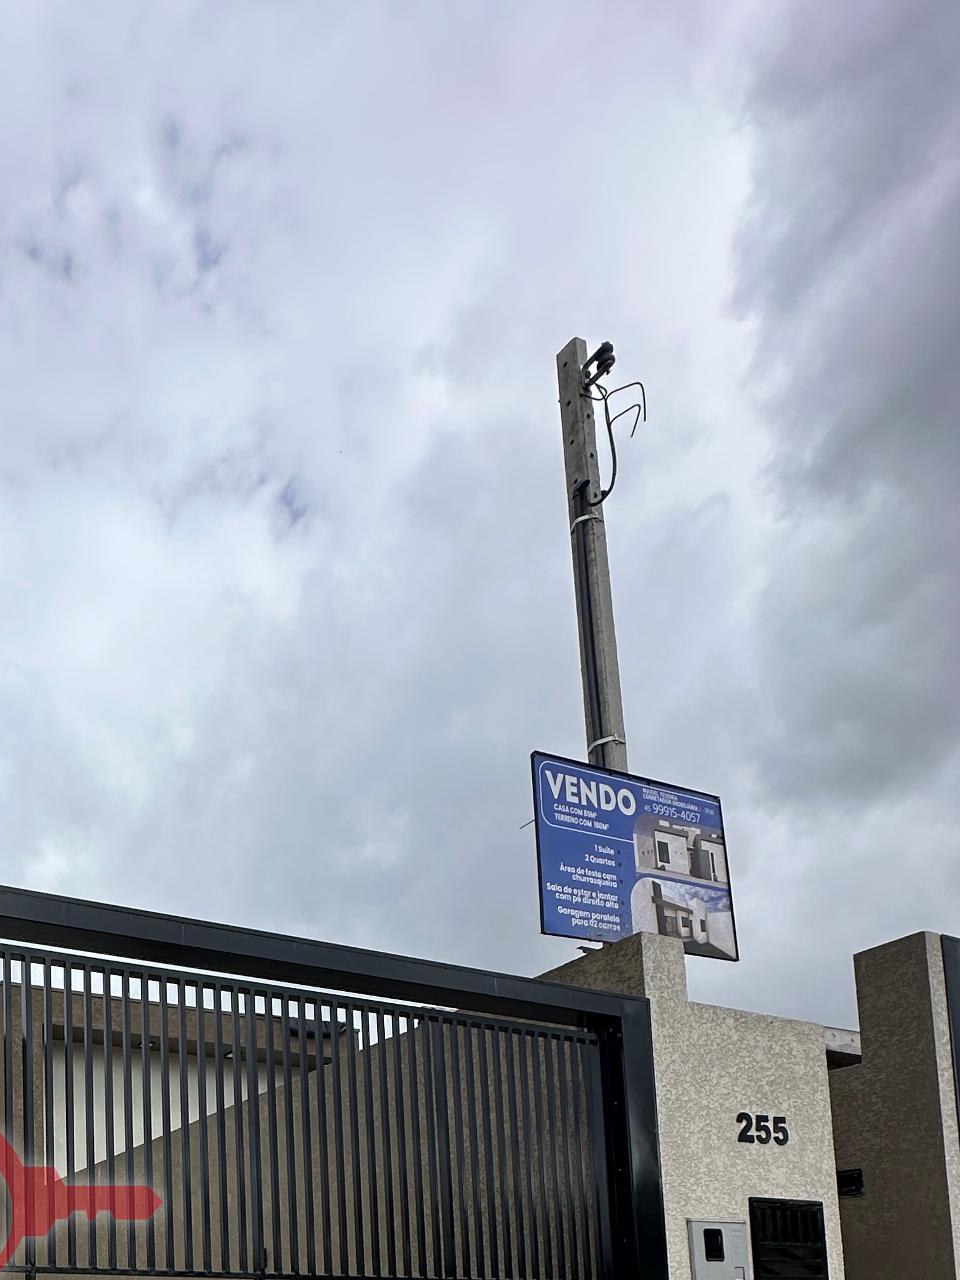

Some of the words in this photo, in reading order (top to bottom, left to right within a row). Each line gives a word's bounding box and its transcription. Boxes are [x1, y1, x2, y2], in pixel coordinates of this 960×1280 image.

[545, 770, 636, 816] VENDO
[554, 803, 569, 813] CASA
[570, 806, 583, 816] COM
[652, 803, 701, 823] 99915-4057
[554, 812, 579, 824] TERRENO
[579, 818, 592, 828] COM
[590, 855, 616, 867] Quartos
[560, 862, 576, 873] Área
[576, 866, 585, 874] de
[602, 872, 617, 880] com
[572, 873, 618, 888] churrasqueira
[546, 882, 562, 892] Sala
[563, 885, 572, 893] de
[573, 887, 591, 897] estar
[597, 890, 619, 902] jantar
[555, 892, 572, 901] com
[572, 894, 582, 904] pé
[582, 895, 605, 906] direito
[605, 900, 619, 909] alto
[557, 905, 591, 918] Garagem
[591, 911, 620, 923] paralela
[572, 917, 589, 926] para
[589, 920, 598, 928] 02
[598, 922, 621, 931] carros
[736, 1111, 789, 1146] 255
